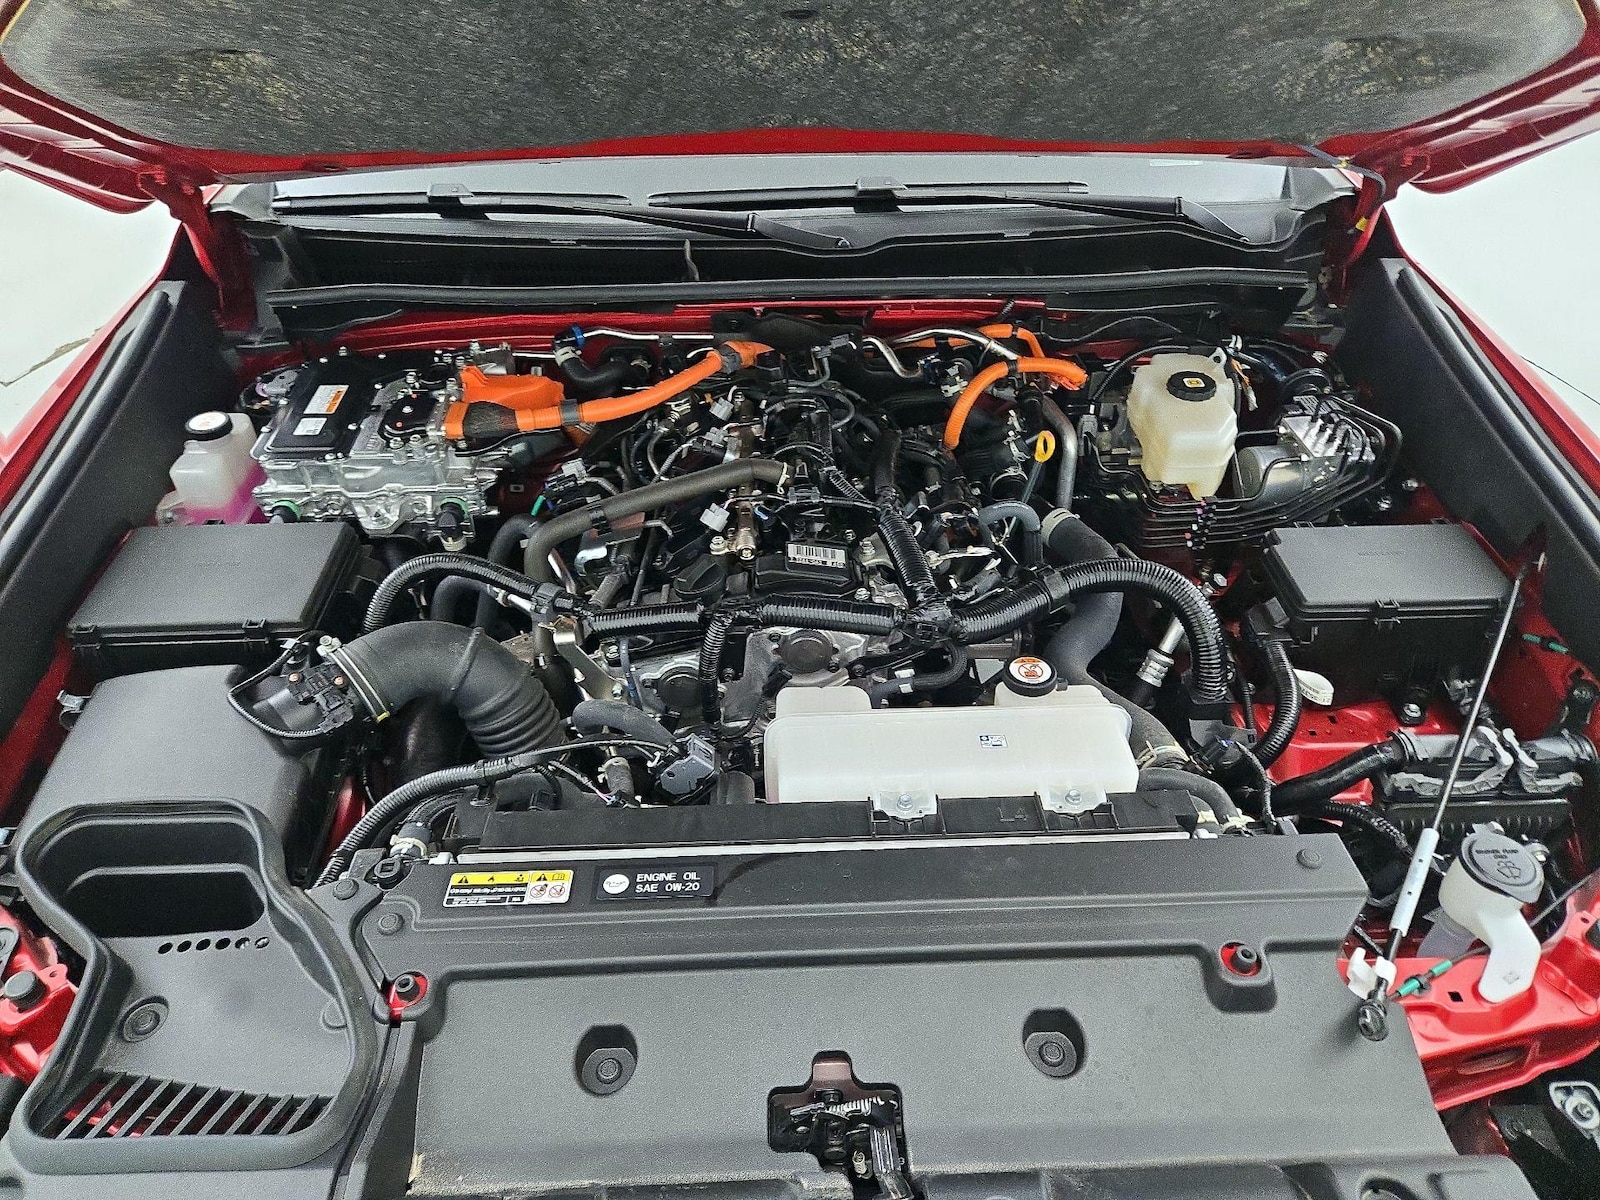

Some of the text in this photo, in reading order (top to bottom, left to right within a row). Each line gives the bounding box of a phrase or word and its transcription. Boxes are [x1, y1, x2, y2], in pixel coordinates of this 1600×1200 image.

[636, 872, 701, 882] ENGINE OIL
[635, 882, 700, 893] SAE 0W-20
